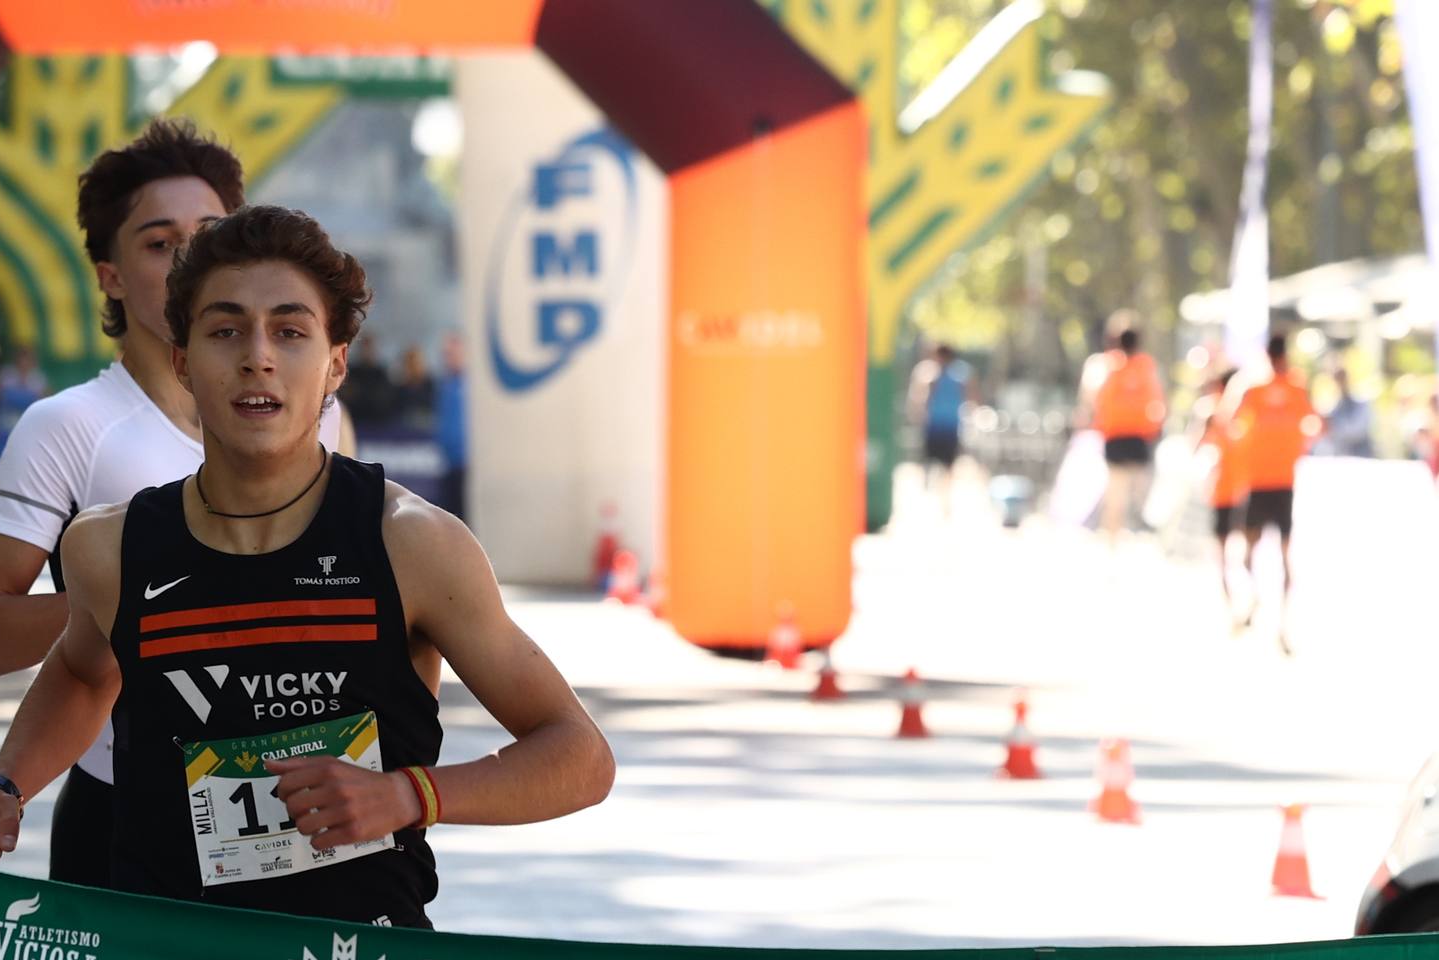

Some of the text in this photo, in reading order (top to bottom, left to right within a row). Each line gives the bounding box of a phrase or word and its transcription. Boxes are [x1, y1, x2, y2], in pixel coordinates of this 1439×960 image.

[532, 162, 603, 347] FMD
[325, 576, 361, 586] POSTIGO
[239, 671, 348, 700] VICKY
[254, 699, 341, 721] FOODS
[231, 726, 327, 750] GRAN PREMIO
[261, 740, 327, 761] CAJA RURAL
[191, 789, 212, 836] MILLA
[254, 839, 293, 851] CAVIDEL
[19, 925, 100, 948] ATLETISMO
